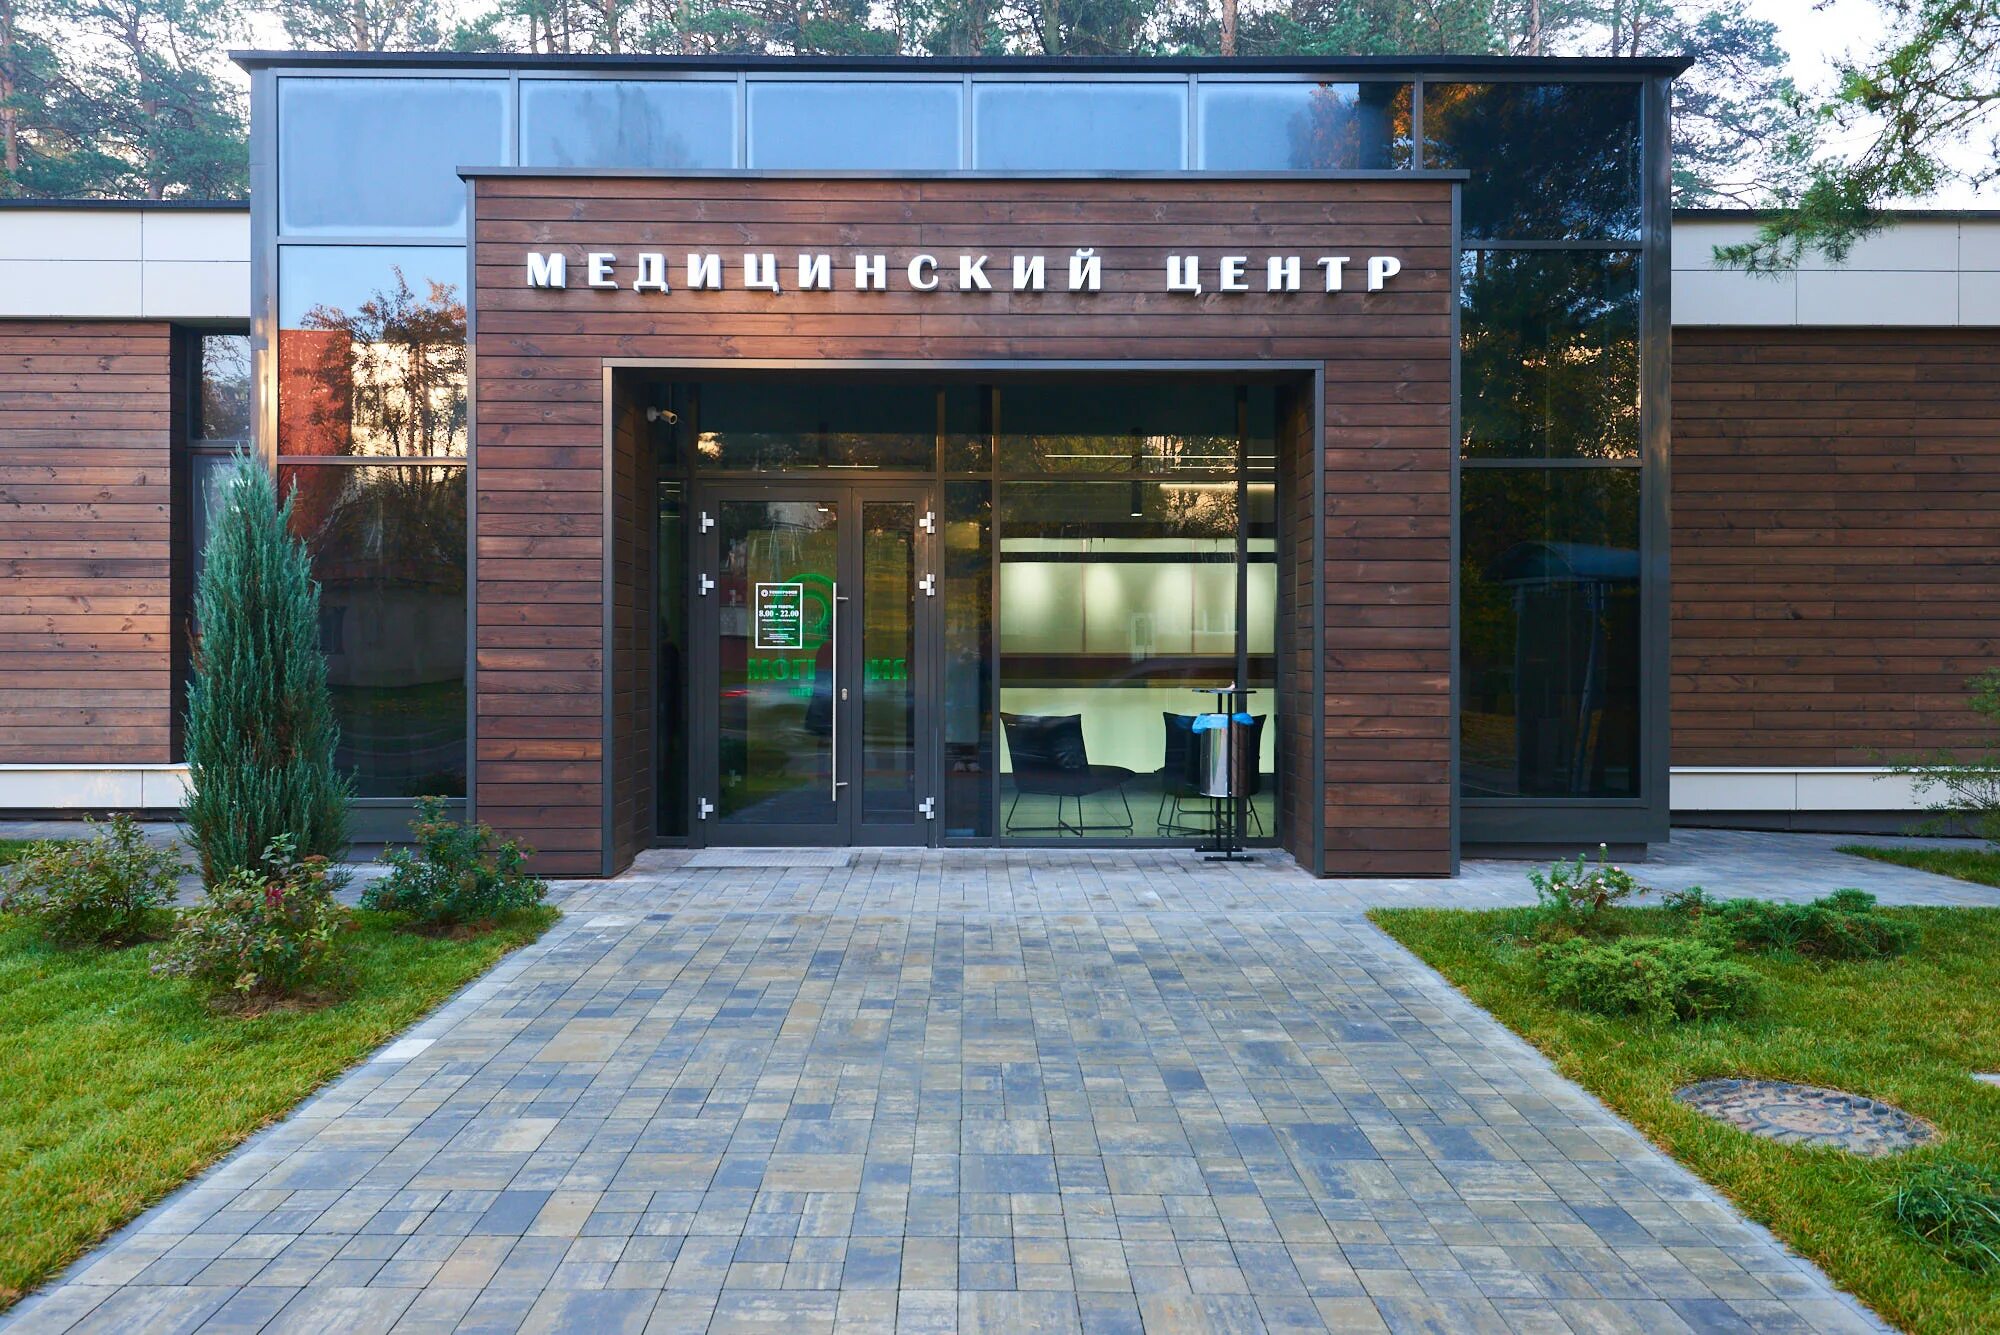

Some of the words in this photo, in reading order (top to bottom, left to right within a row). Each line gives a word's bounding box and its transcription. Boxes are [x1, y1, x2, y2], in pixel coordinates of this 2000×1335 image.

[527, 248, 1101, 294] МЕДИЦИНСКИЙ
[1166, 255, 1401, 297] ЦЕНТР
[758, 609, 774, 617] 8.00
[780, 609, 800, 617] 22.00
